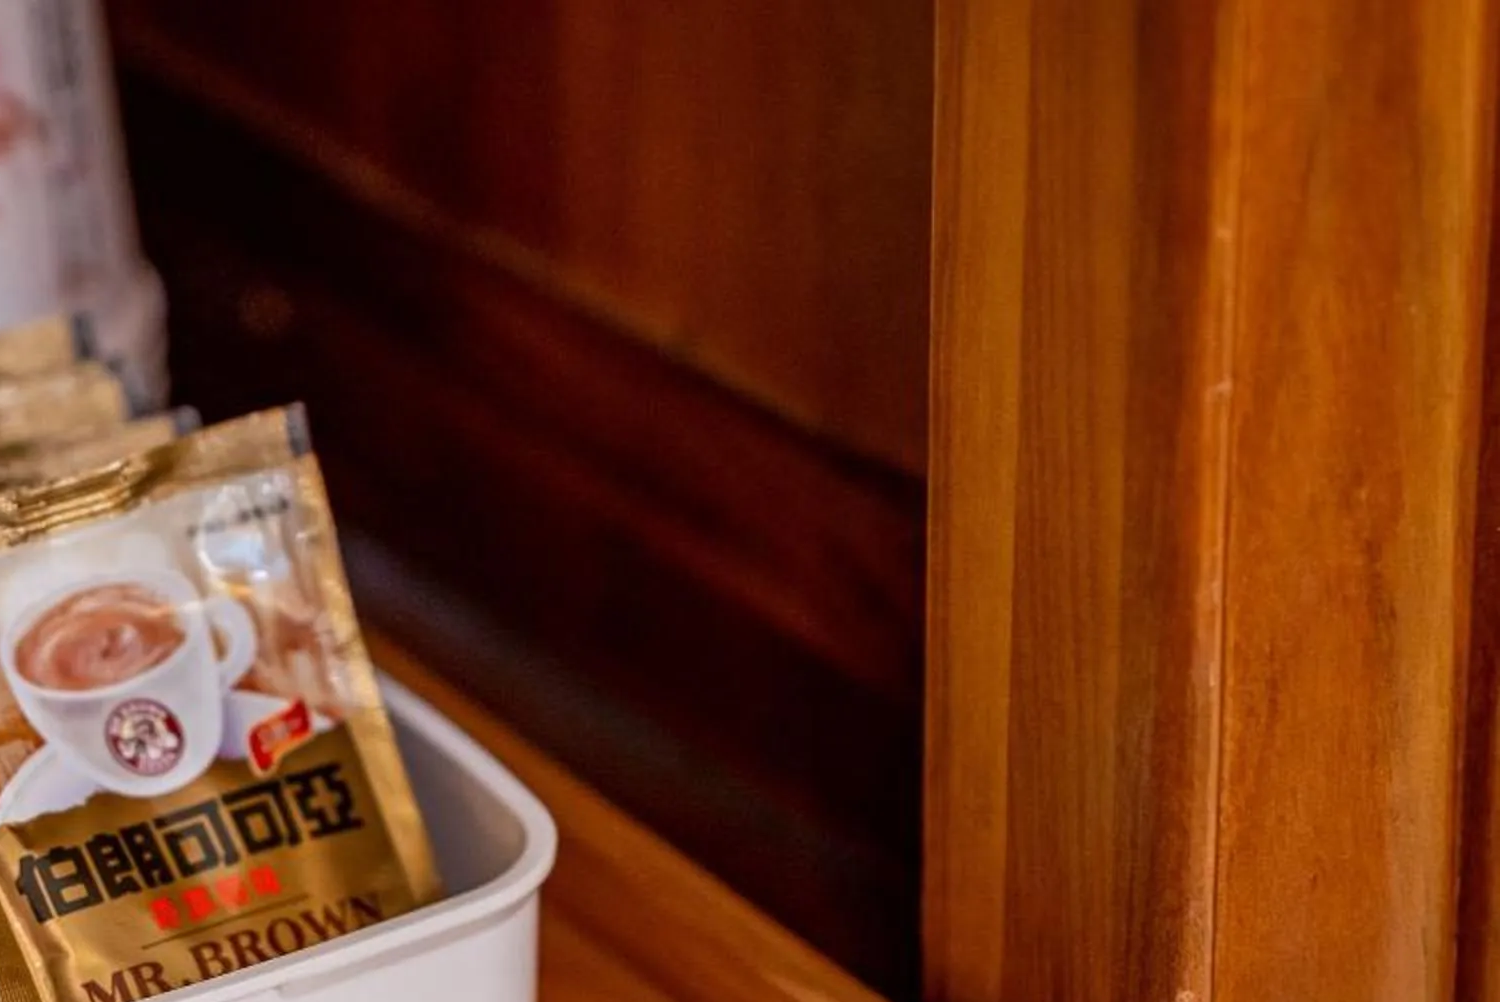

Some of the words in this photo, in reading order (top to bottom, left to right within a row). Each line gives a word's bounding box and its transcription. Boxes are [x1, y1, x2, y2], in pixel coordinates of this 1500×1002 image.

[14, 763, 365, 924] 伯朗可可亞
[188, 892, 386, 982] BROWN
